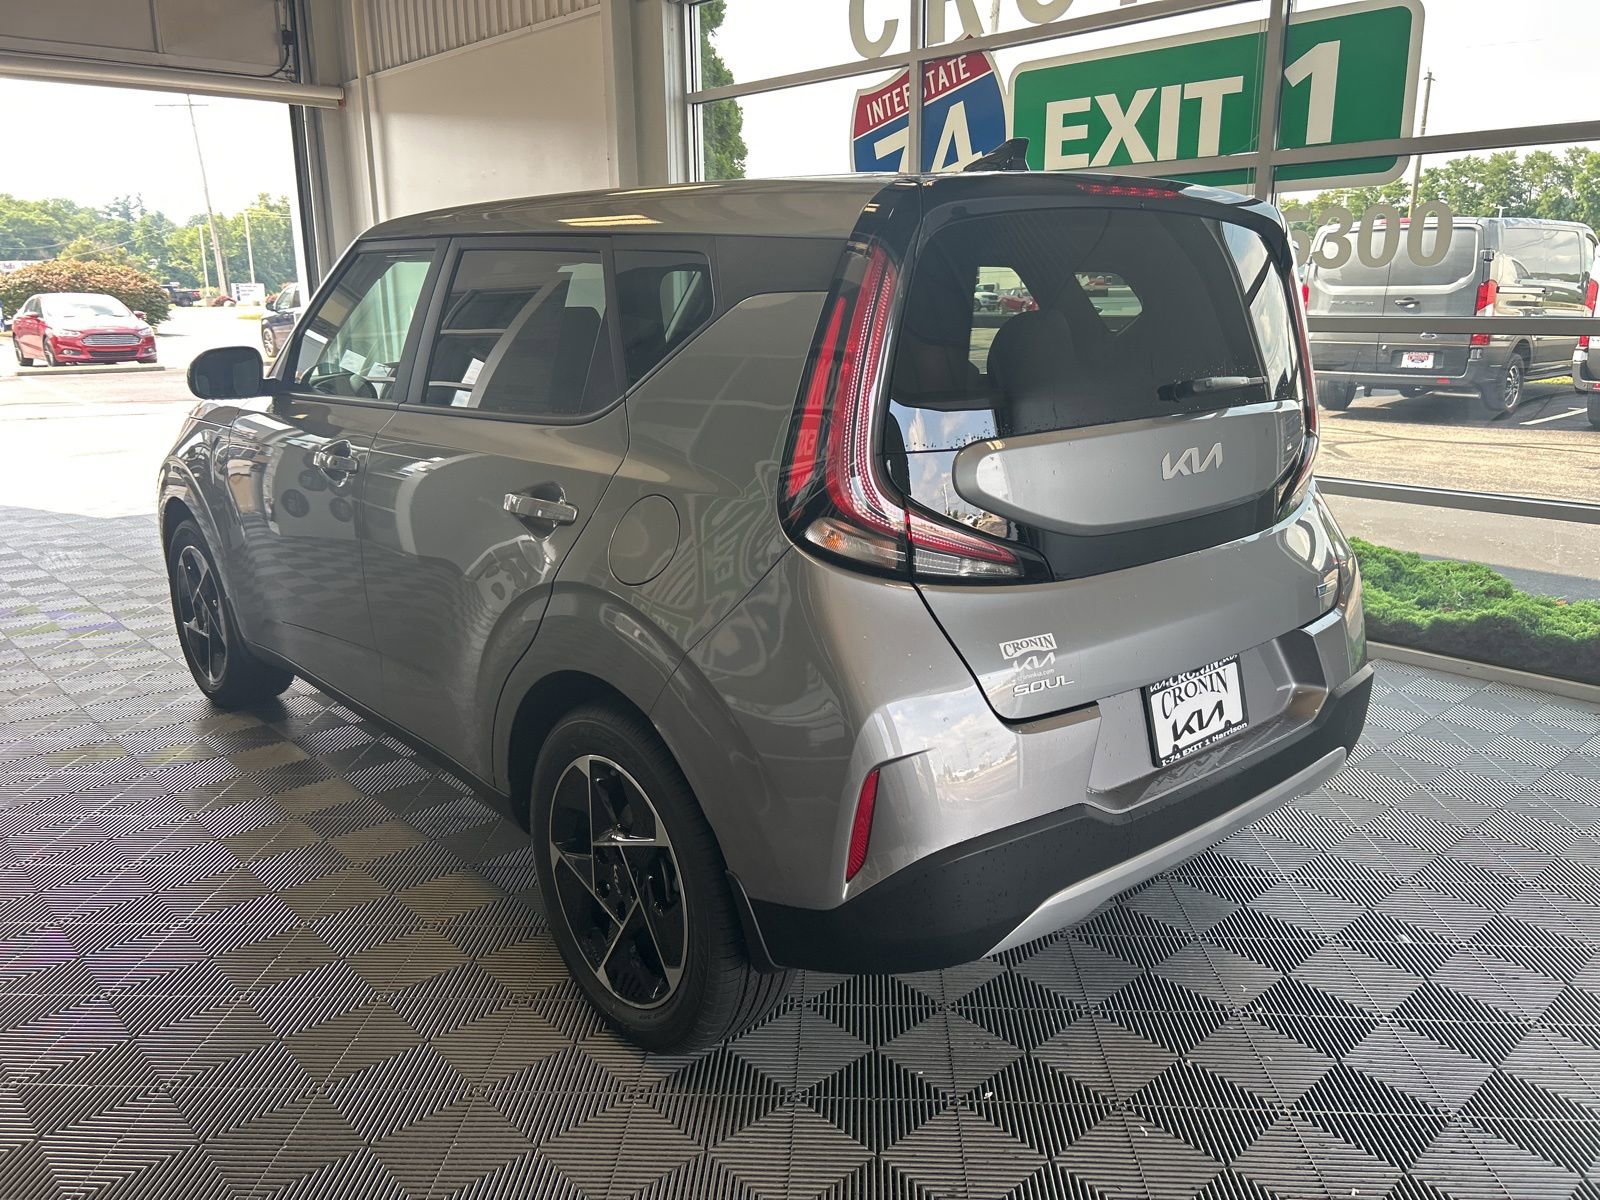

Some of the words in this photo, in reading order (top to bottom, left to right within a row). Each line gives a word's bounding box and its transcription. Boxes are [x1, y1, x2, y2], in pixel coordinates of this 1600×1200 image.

[866, 55, 971, 126] INTERTATE
[1044, 75, 1244, 170] EXIT
[1284, 40, 1341, 146] 1
[1161, 442, 1223, 480] KIA
[1003, 635, 1054, 657] CRONIN
[1013, 651, 1056, 673] KIA
[1013, 675, 1075, 697] SOUL
[1161, 668, 1229, 720] CRONIN
[1171, 699, 1225, 742] KIA
[1161, 753, 1181, 767] I-74
[1182, 741, 1203, 757] EXIT
[1212, 722, 1248, 743] Harrison
